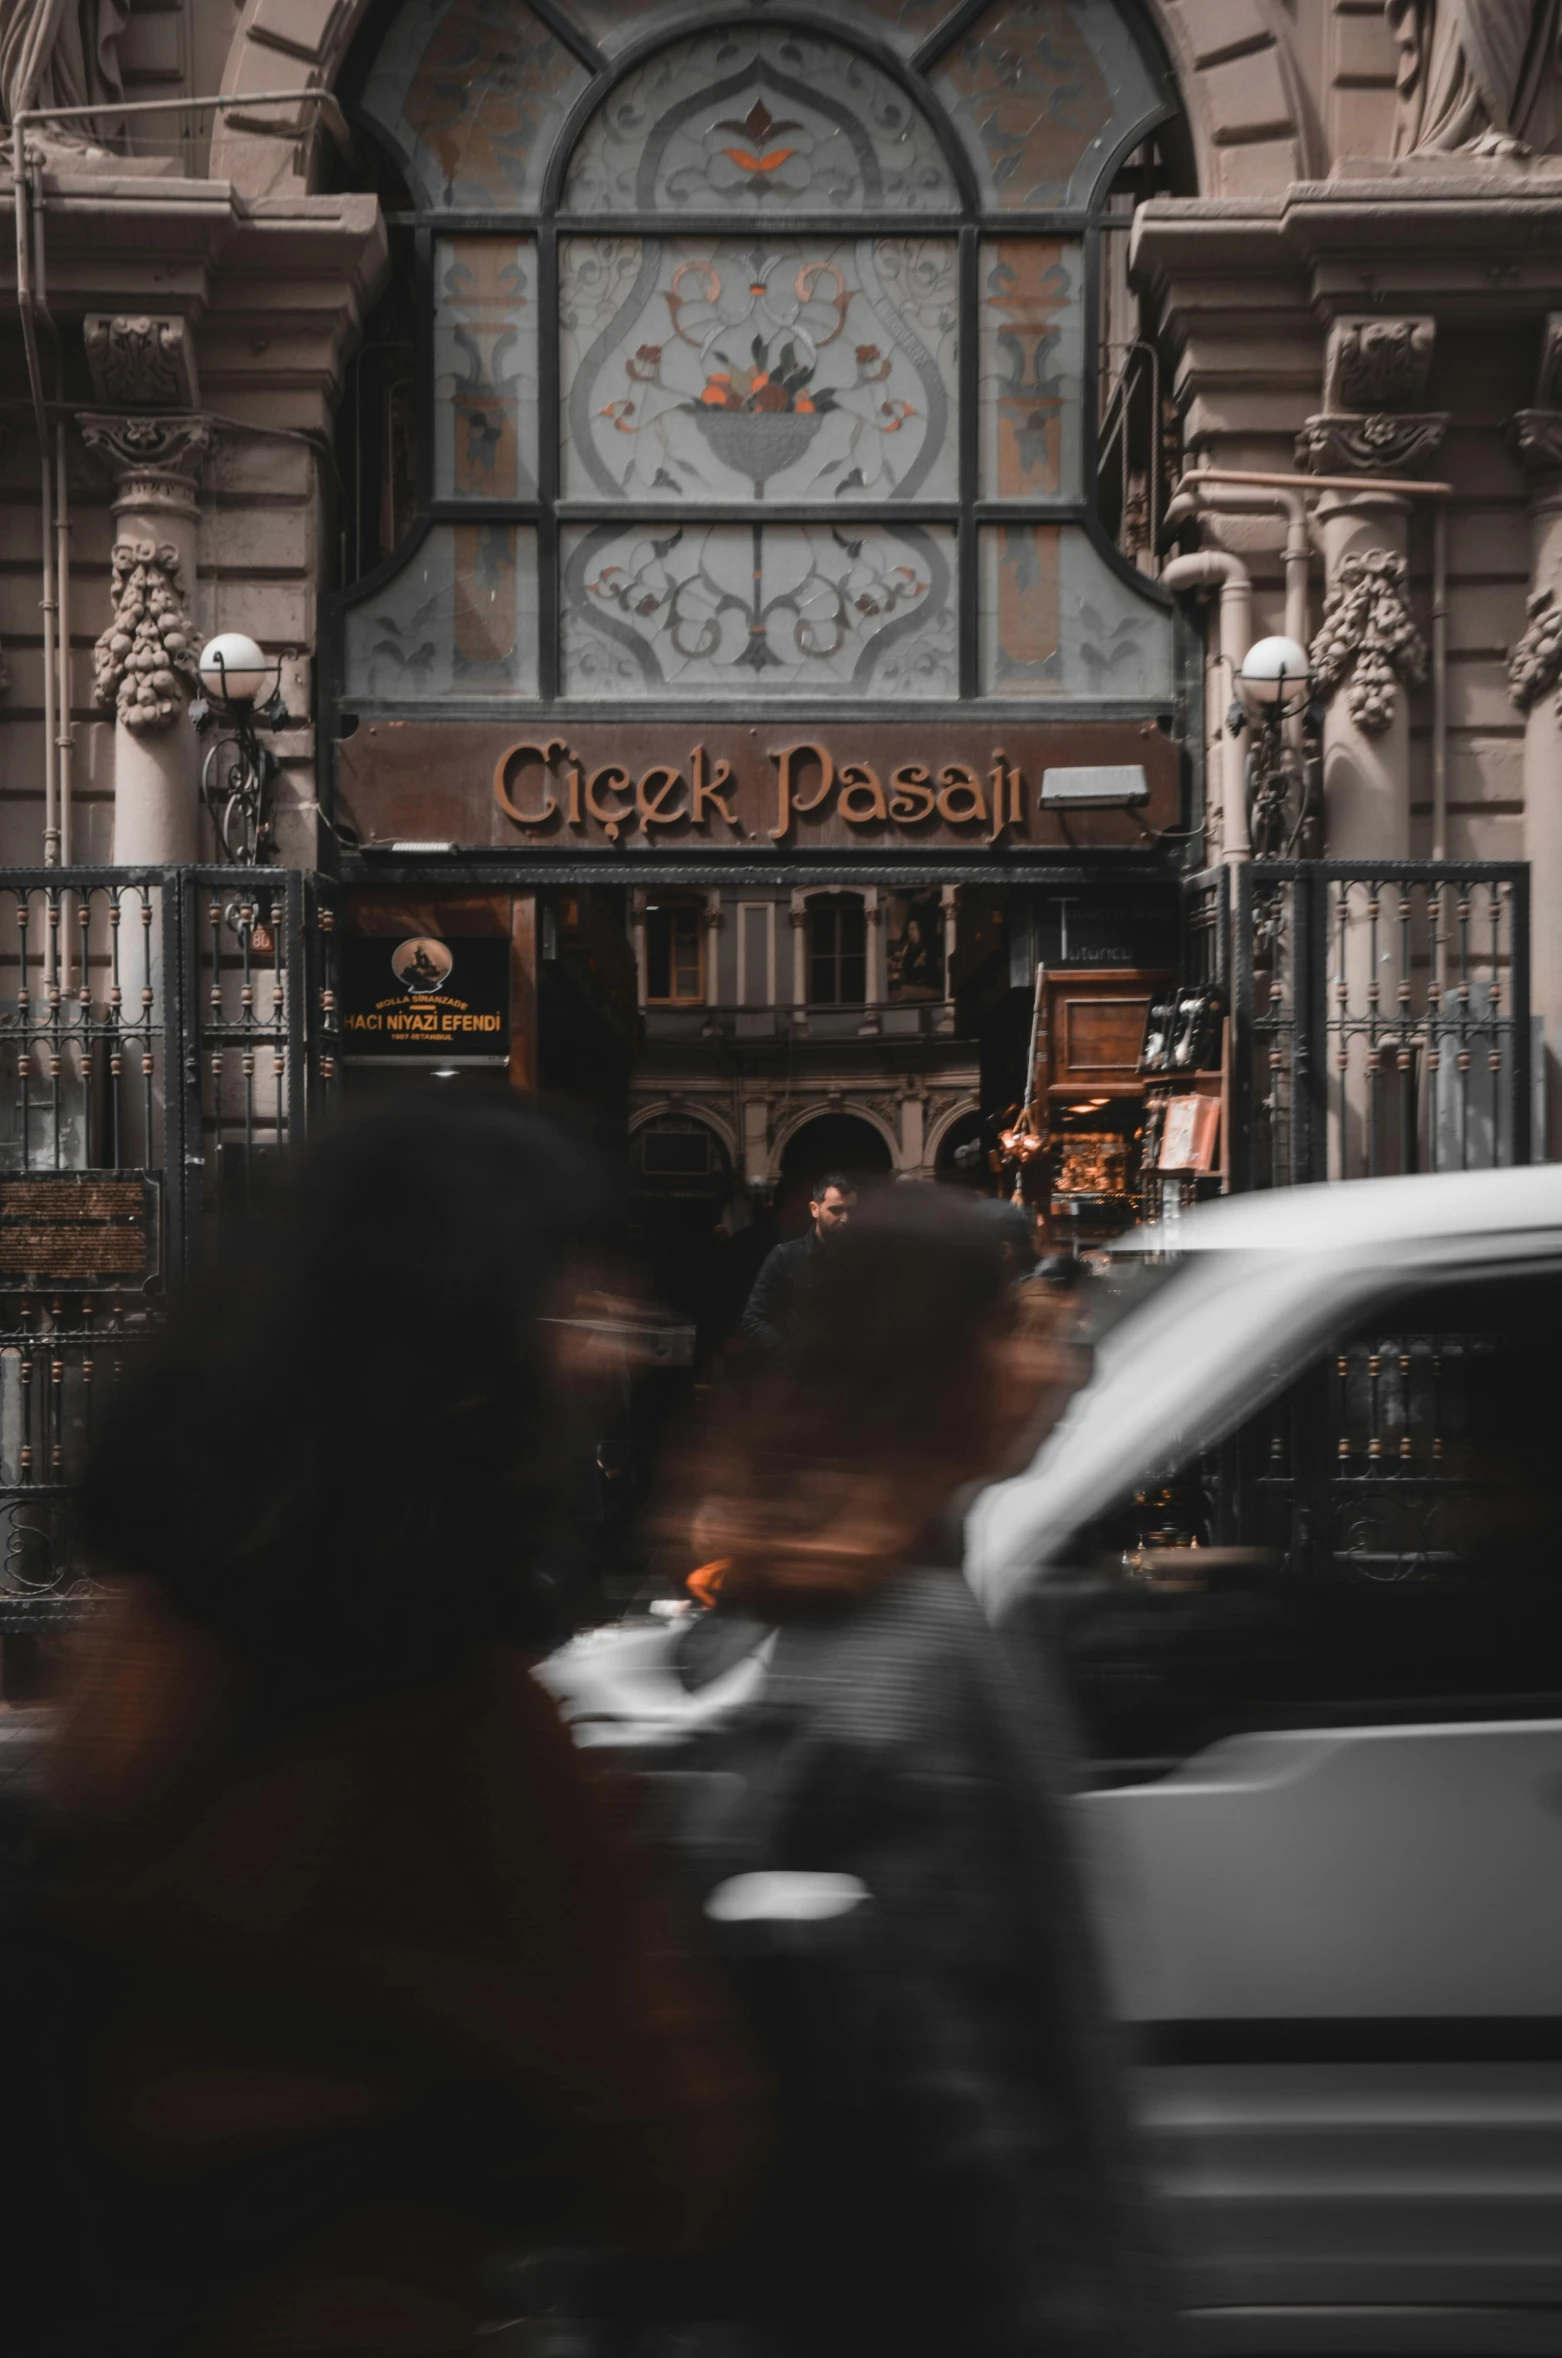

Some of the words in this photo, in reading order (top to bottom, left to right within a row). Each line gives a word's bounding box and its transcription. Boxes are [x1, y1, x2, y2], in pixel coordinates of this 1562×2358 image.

[375, 996, 410, 1010] MOLLA
[343, 1014, 382, 1031] HACI
[386, 1010, 438, 1031] NİYAZİ
[441, 1010, 501, 1031] EFENDİ
